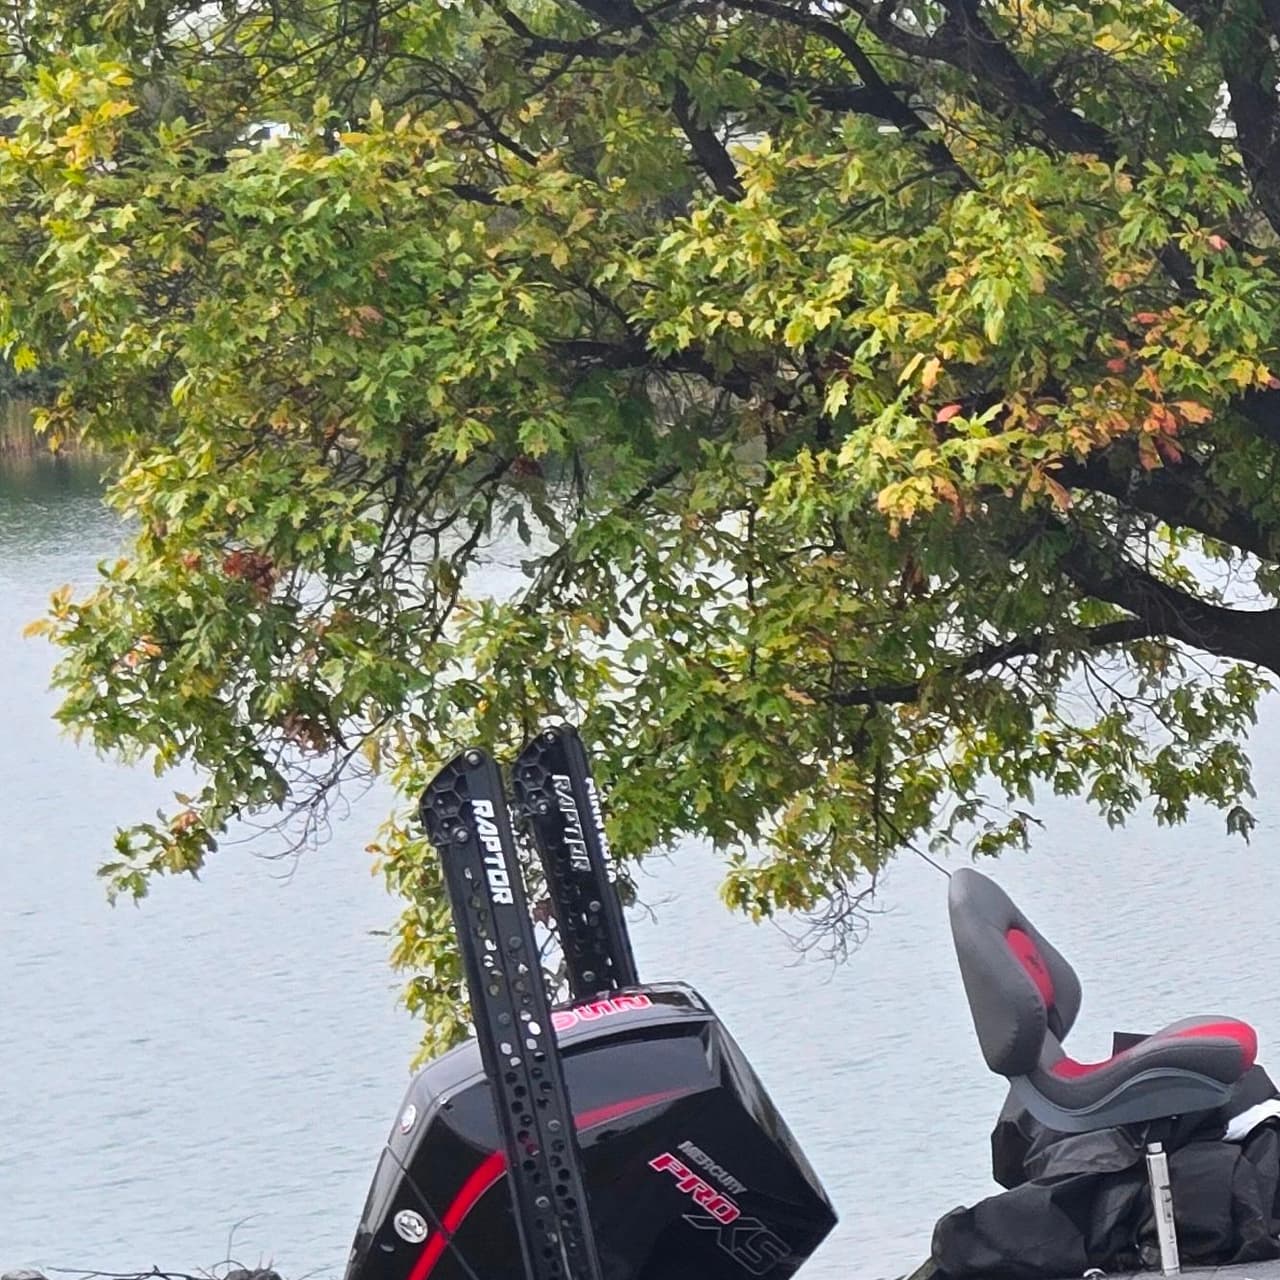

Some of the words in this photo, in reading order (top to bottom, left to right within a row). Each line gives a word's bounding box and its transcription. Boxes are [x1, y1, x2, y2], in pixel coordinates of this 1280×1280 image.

[471, 799, 514, 905] RAPTOR
[647, 1151, 742, 1225] PRO
[677, 1140, 748, 1195] MERCURY
[682, 1213, 793, 1276] XS
